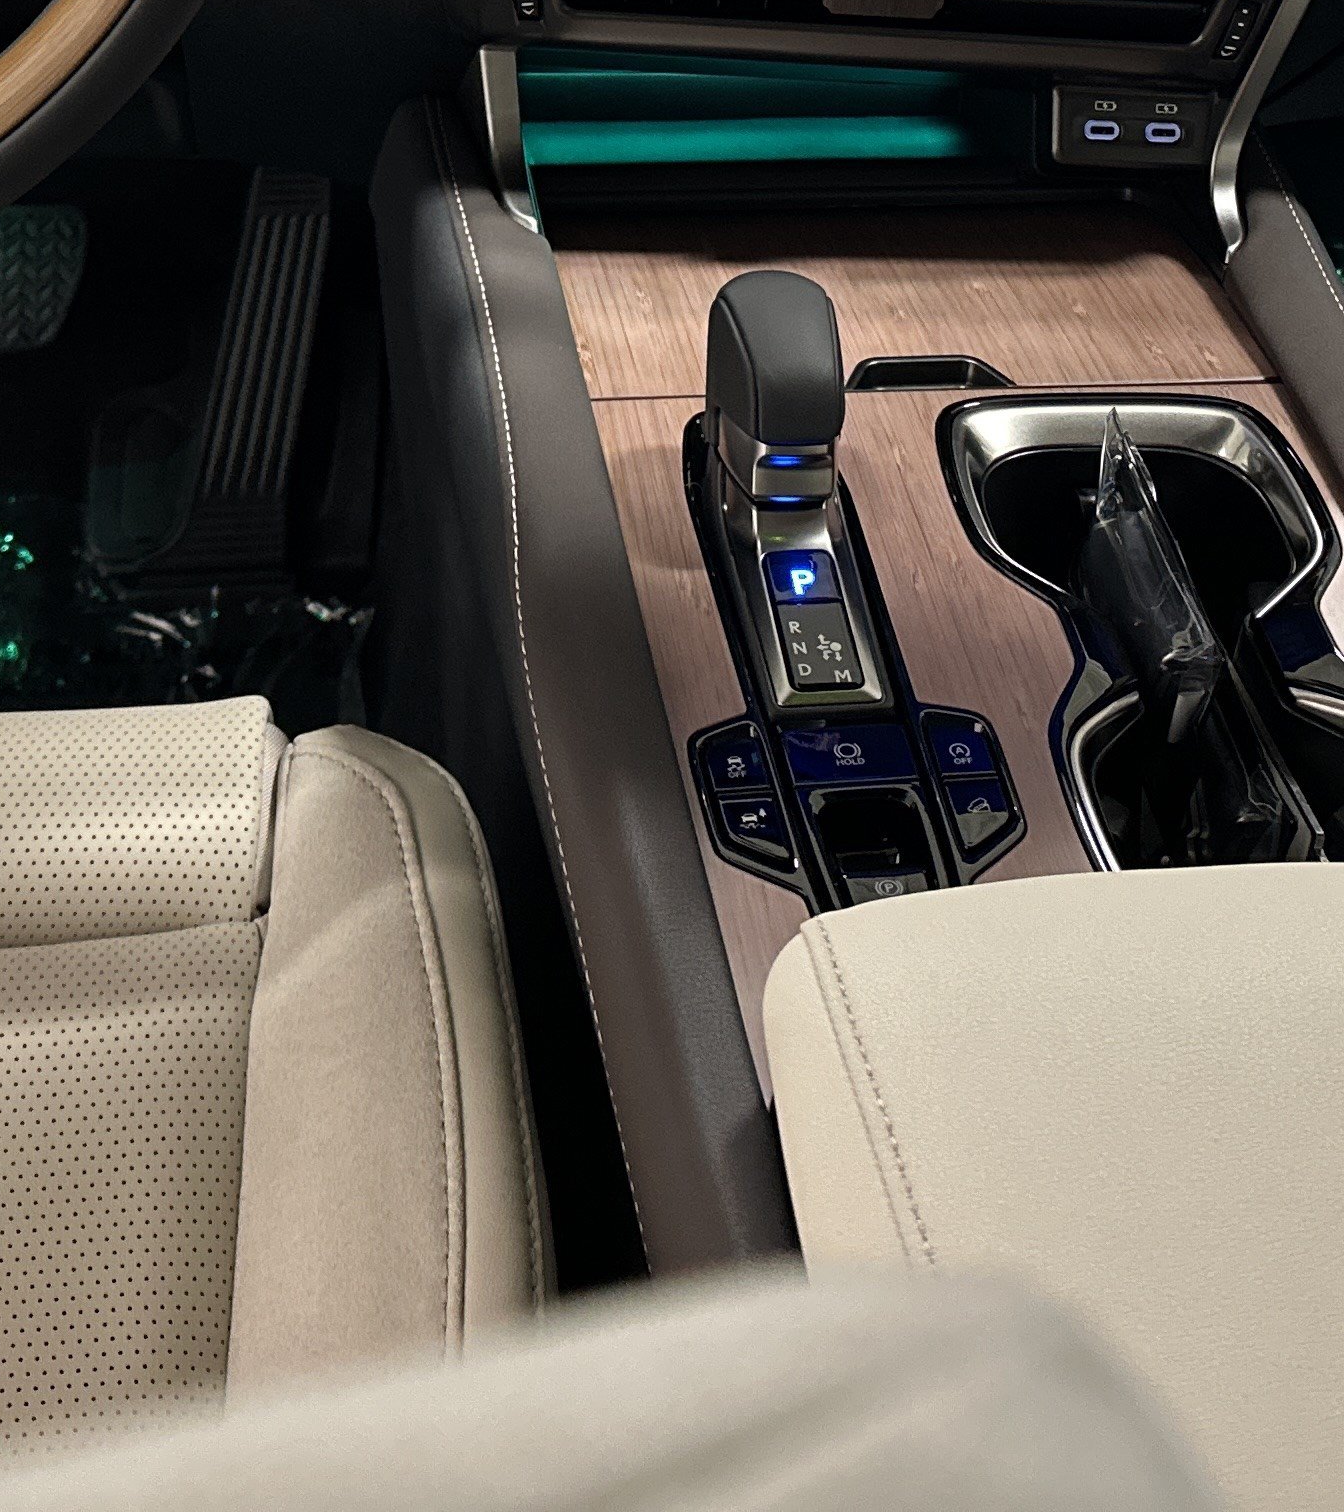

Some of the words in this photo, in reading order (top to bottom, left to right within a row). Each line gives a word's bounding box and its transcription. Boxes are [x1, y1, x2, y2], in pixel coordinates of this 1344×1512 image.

[790, 568, 816, 596] P
[788, 621, 802, 635] R
[792, 641, 807, 655] N
[797, 663, 812, 677] D
[834, 669, 852, 683] M
[835, 757, 866, 766] HOLD
[953, 757, 973, 765] OFF
